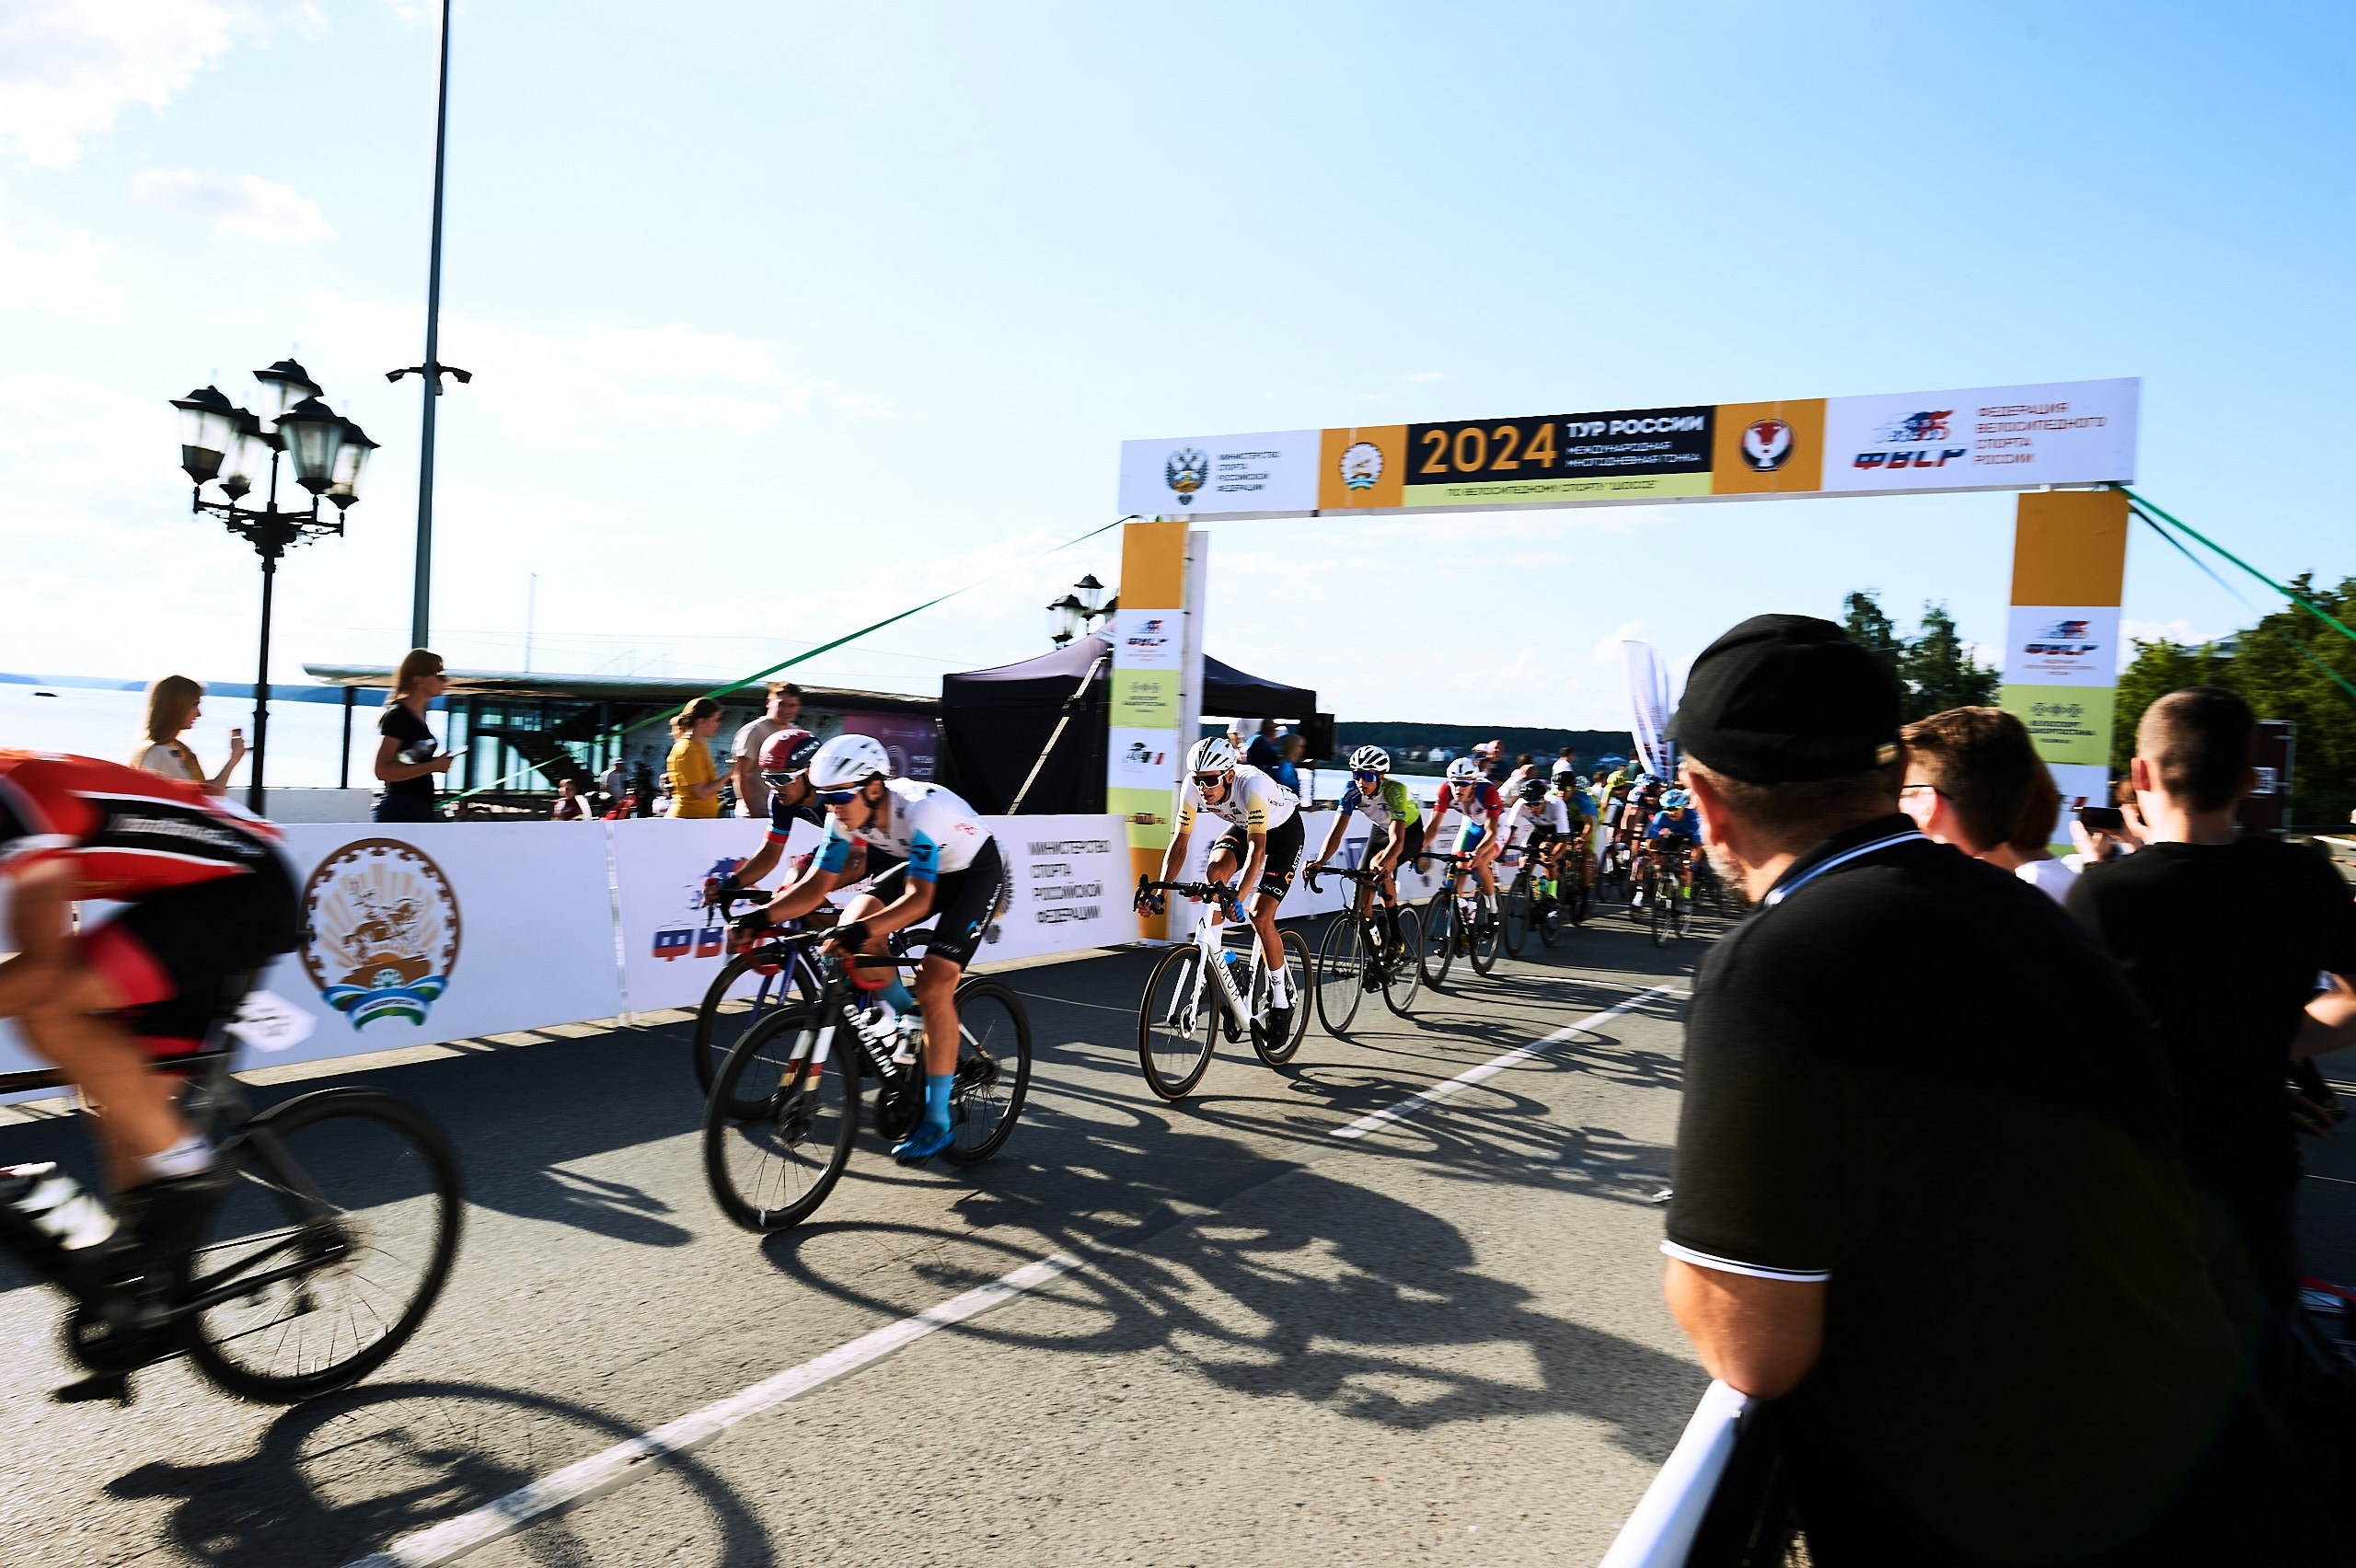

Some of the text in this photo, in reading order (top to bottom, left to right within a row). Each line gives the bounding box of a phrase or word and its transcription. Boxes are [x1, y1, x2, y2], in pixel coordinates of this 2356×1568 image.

[1565, 415, 1705, 438] ТУР РОССИИ
[1419, 423, 1558, 473] 2024
[1027, 840, 1112, 856] МИНИСТЕРСТВО
[1030, 863, 1074, 878] СПОРТА
[1032, 880, 1104, 901] РОССИЙСКОЙ
[1035, 905, 1103, 924] ФЕДЕРАЦИИ
